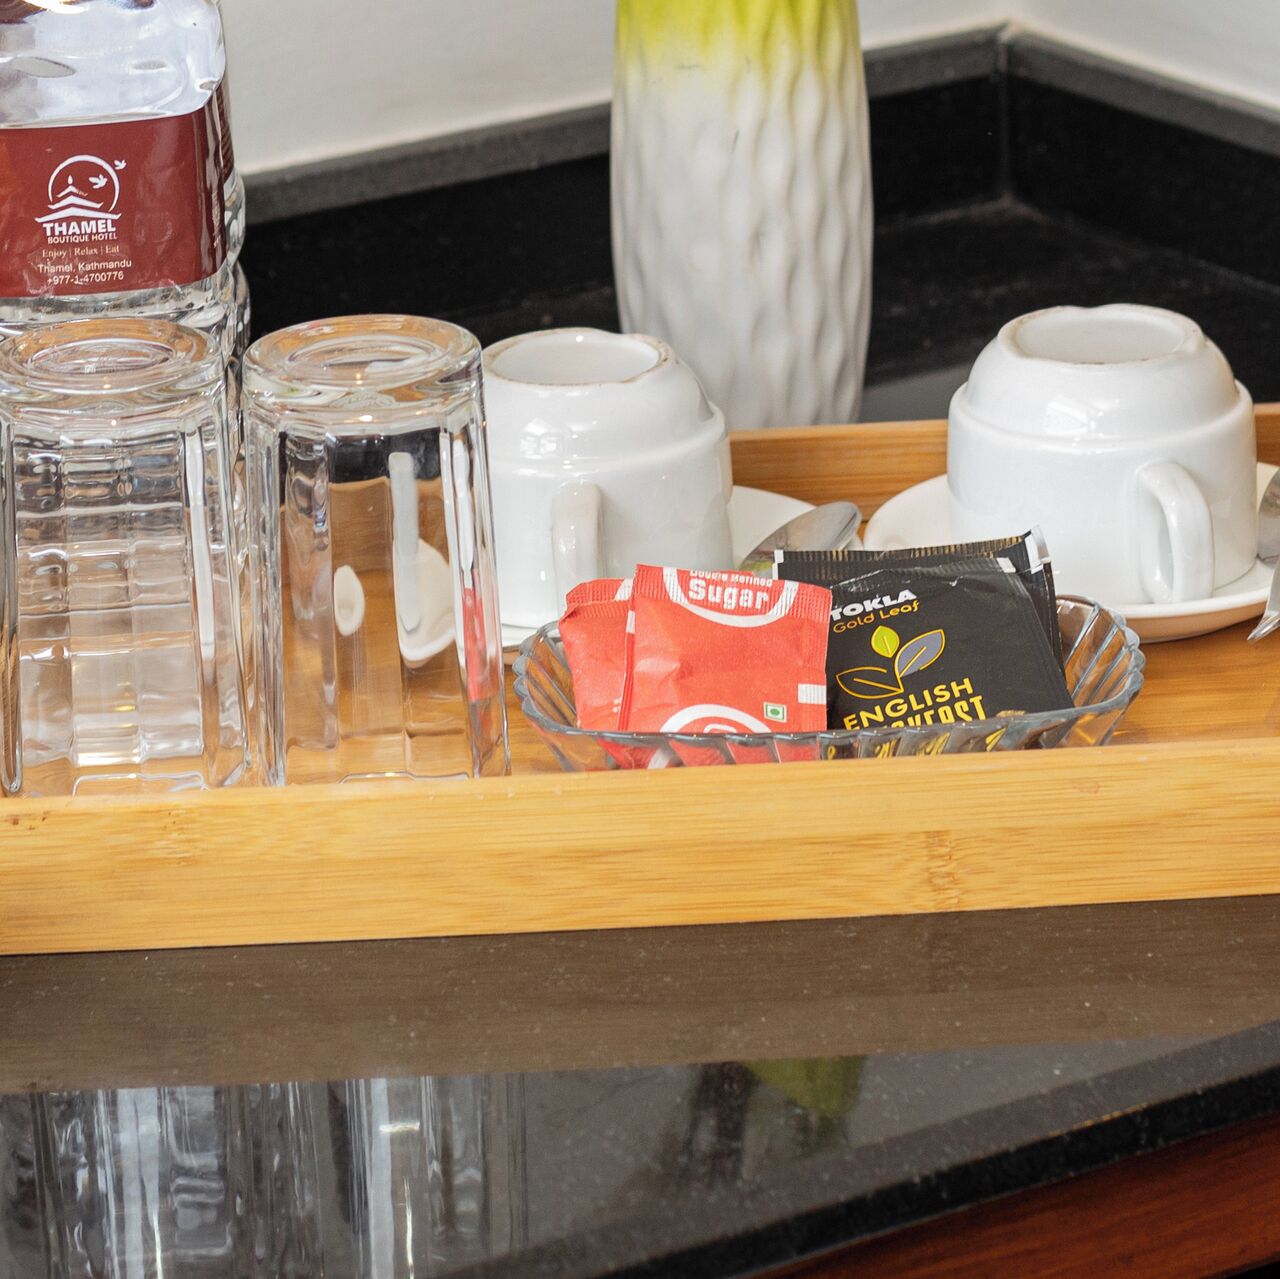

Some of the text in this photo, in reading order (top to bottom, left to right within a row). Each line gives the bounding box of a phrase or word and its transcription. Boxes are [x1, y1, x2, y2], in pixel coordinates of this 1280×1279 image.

[43, 219, 116, 236] THAMEL
[48, 232, 117, 244] BOUTIQUE HOTEL
[42, 245, 120, 258] Enjoy Relax Eat
[37, 259, 132, 273] Thamel, Kathmandu
[689, 578, 768, 609] Sugar
[830, 589, 917, 620] TOKLA
[833, 600, 919, 633] Gold Leaf
[843, 678, 973, 730] ENGLISH
